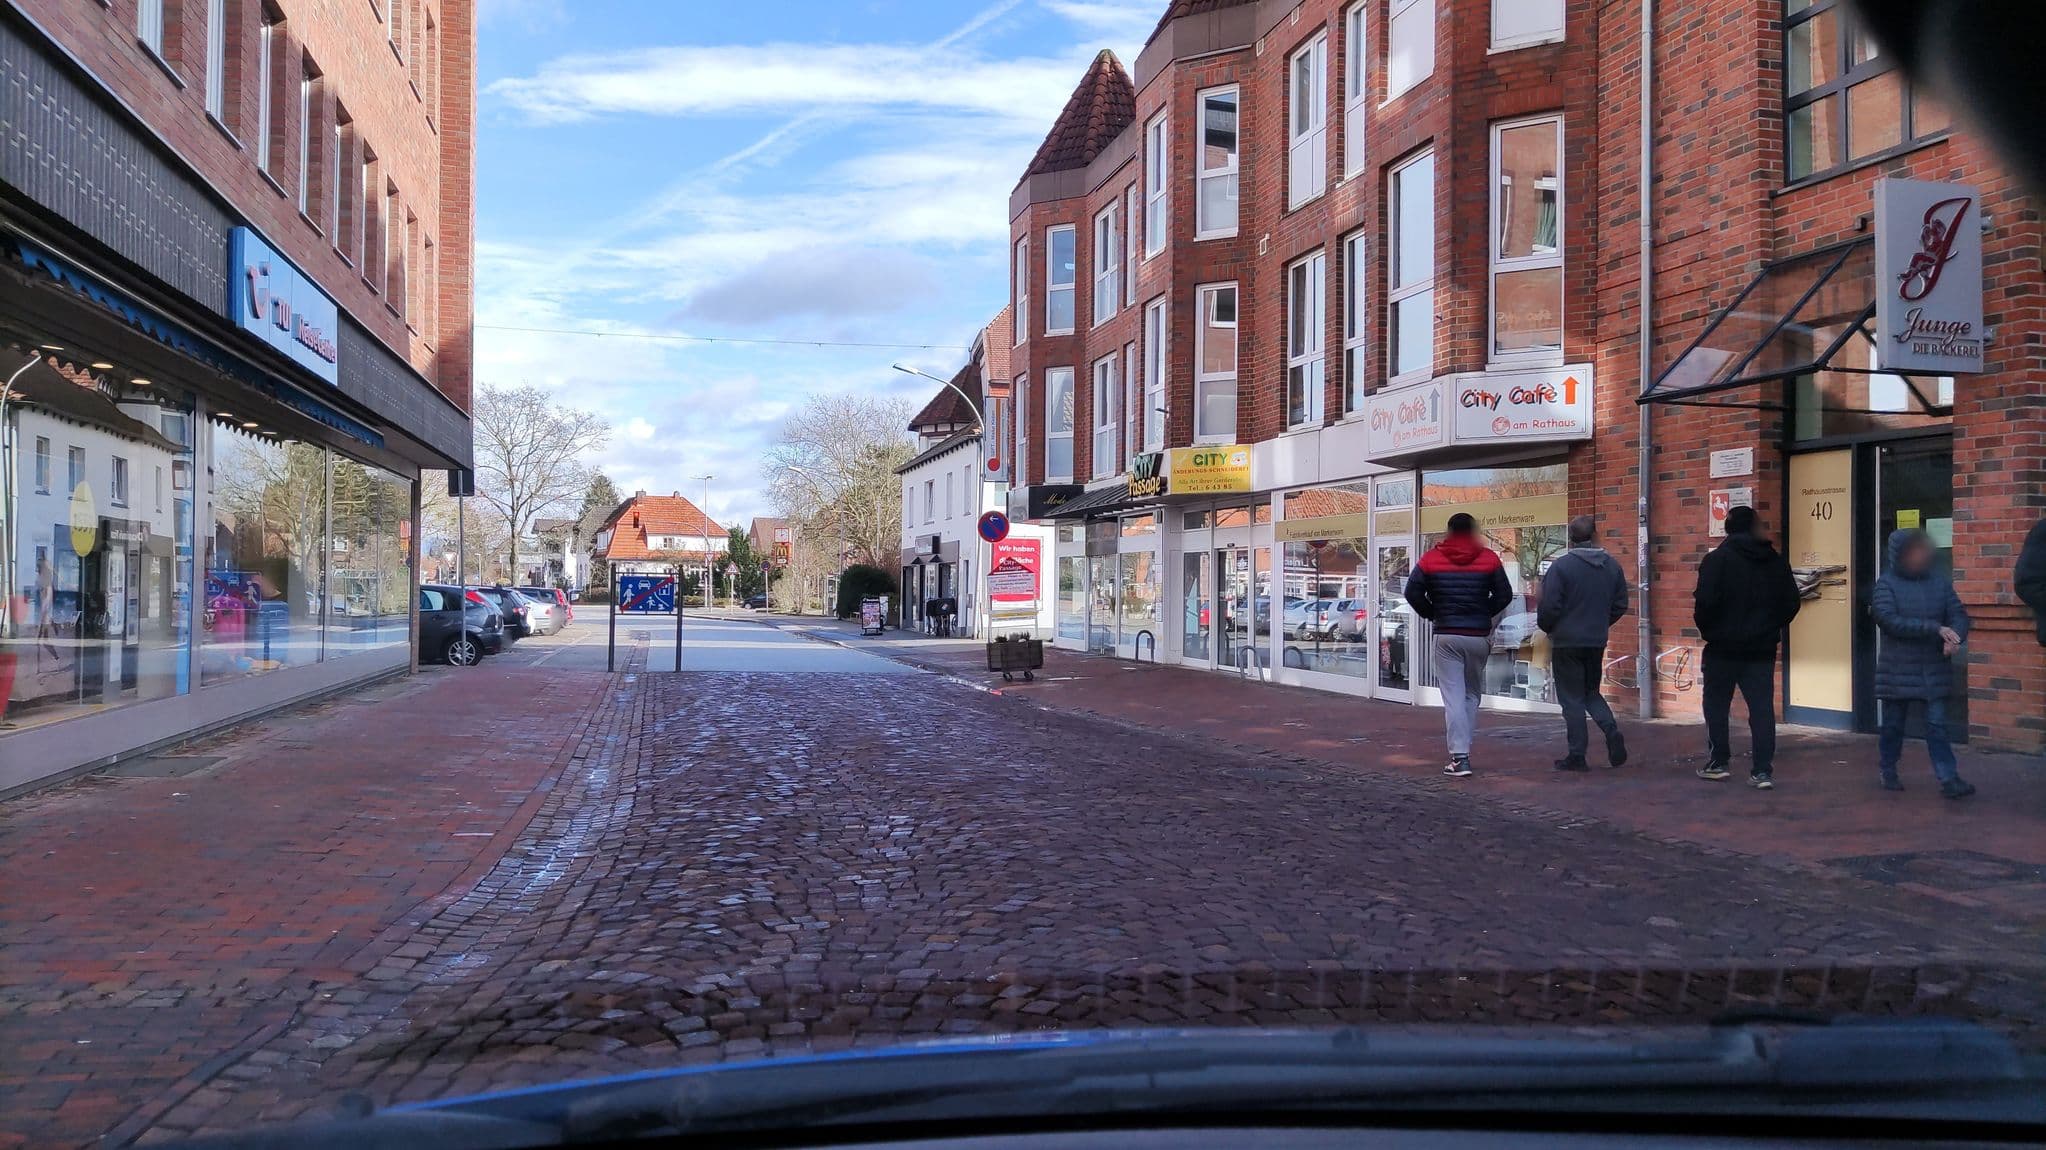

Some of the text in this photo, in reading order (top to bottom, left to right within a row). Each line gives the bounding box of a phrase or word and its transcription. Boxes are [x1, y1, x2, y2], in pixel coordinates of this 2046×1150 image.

[1893, 307, 1972, 344] Junge
[1912, 341, 1931, 355] DIE
[1460, 388, 1502, 412] City
[1371, 408, 1395, 435] City
[1513, 417, 1577, 430] am Rathaus
[1401, 424, 1439, 441] am Rathaus
[1193, 453, 1228, 467] CITY
[1127, 471, 1161, 496] Passage
[1486, 517, 1497, 526] von
[1498, 512, 1536, 525] Markenware
[1811, 501, 1833, 521] 40
